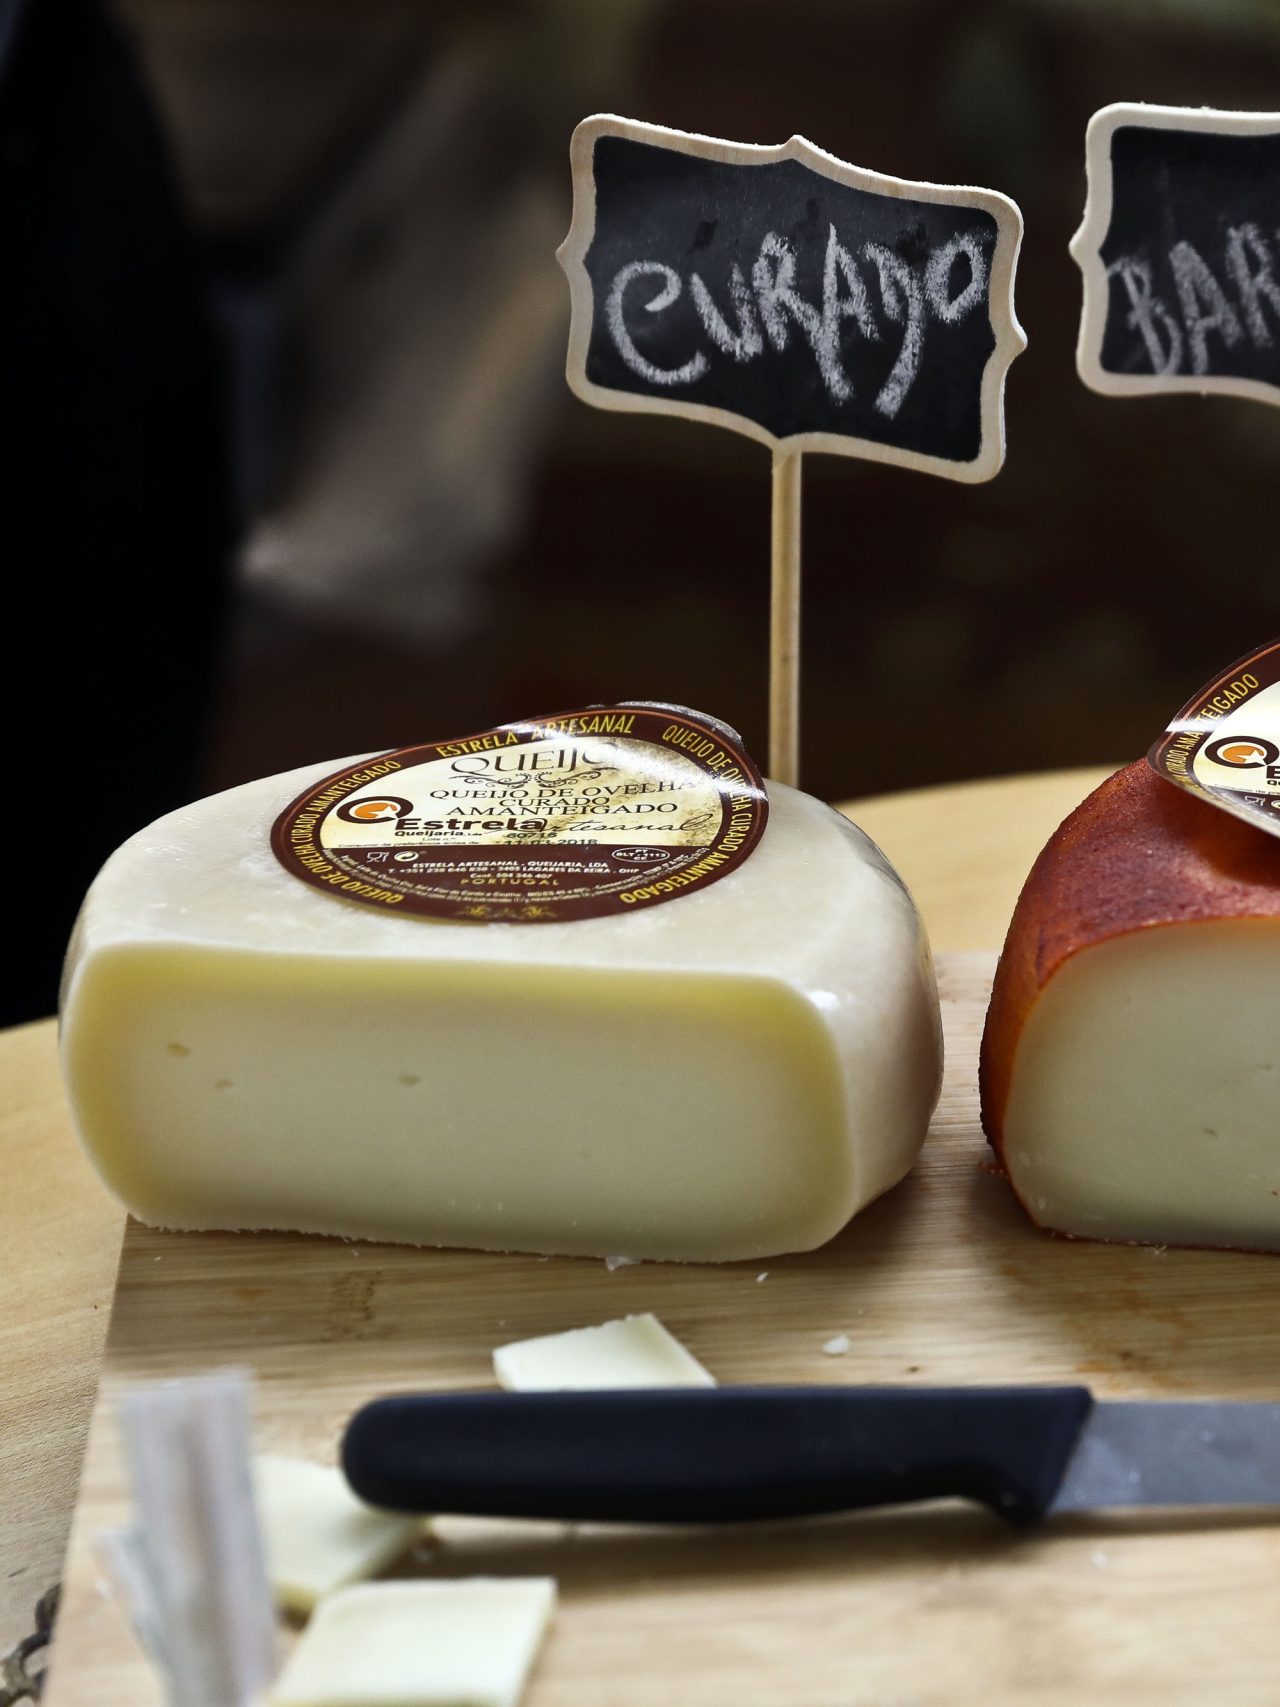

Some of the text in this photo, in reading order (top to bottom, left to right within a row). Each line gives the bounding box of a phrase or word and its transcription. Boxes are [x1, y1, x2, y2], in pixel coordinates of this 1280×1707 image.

[606, 222, 990, 419] CURADO
[1173, 674, 1259, 750] AMATEIGADO
[435, 731, 518, 758] ESTRELA
[662, 725, 715, 758] QUEIJO
[706, 751, 731, 771] DE
[314, 760, 401, 812] AMANTEIGADO
[429, 781, 697, 800] QUEIJO DE OVELHA
[446, 803, 678, 816] AMANTEIGADO
[499, 797, 610, 806] CURADO
[291, 813, 321, 843] CURADO
[395, 818, 546, 831] Estrela
[717, 813, 752, 852] CURADO
[293, 844, 332, 874] OVELHA
[320, 871, 346, 885] DE
[342, 878, 404, 904] QUEIJO
[619, 851, 730, 904] AMANTEIGADO
